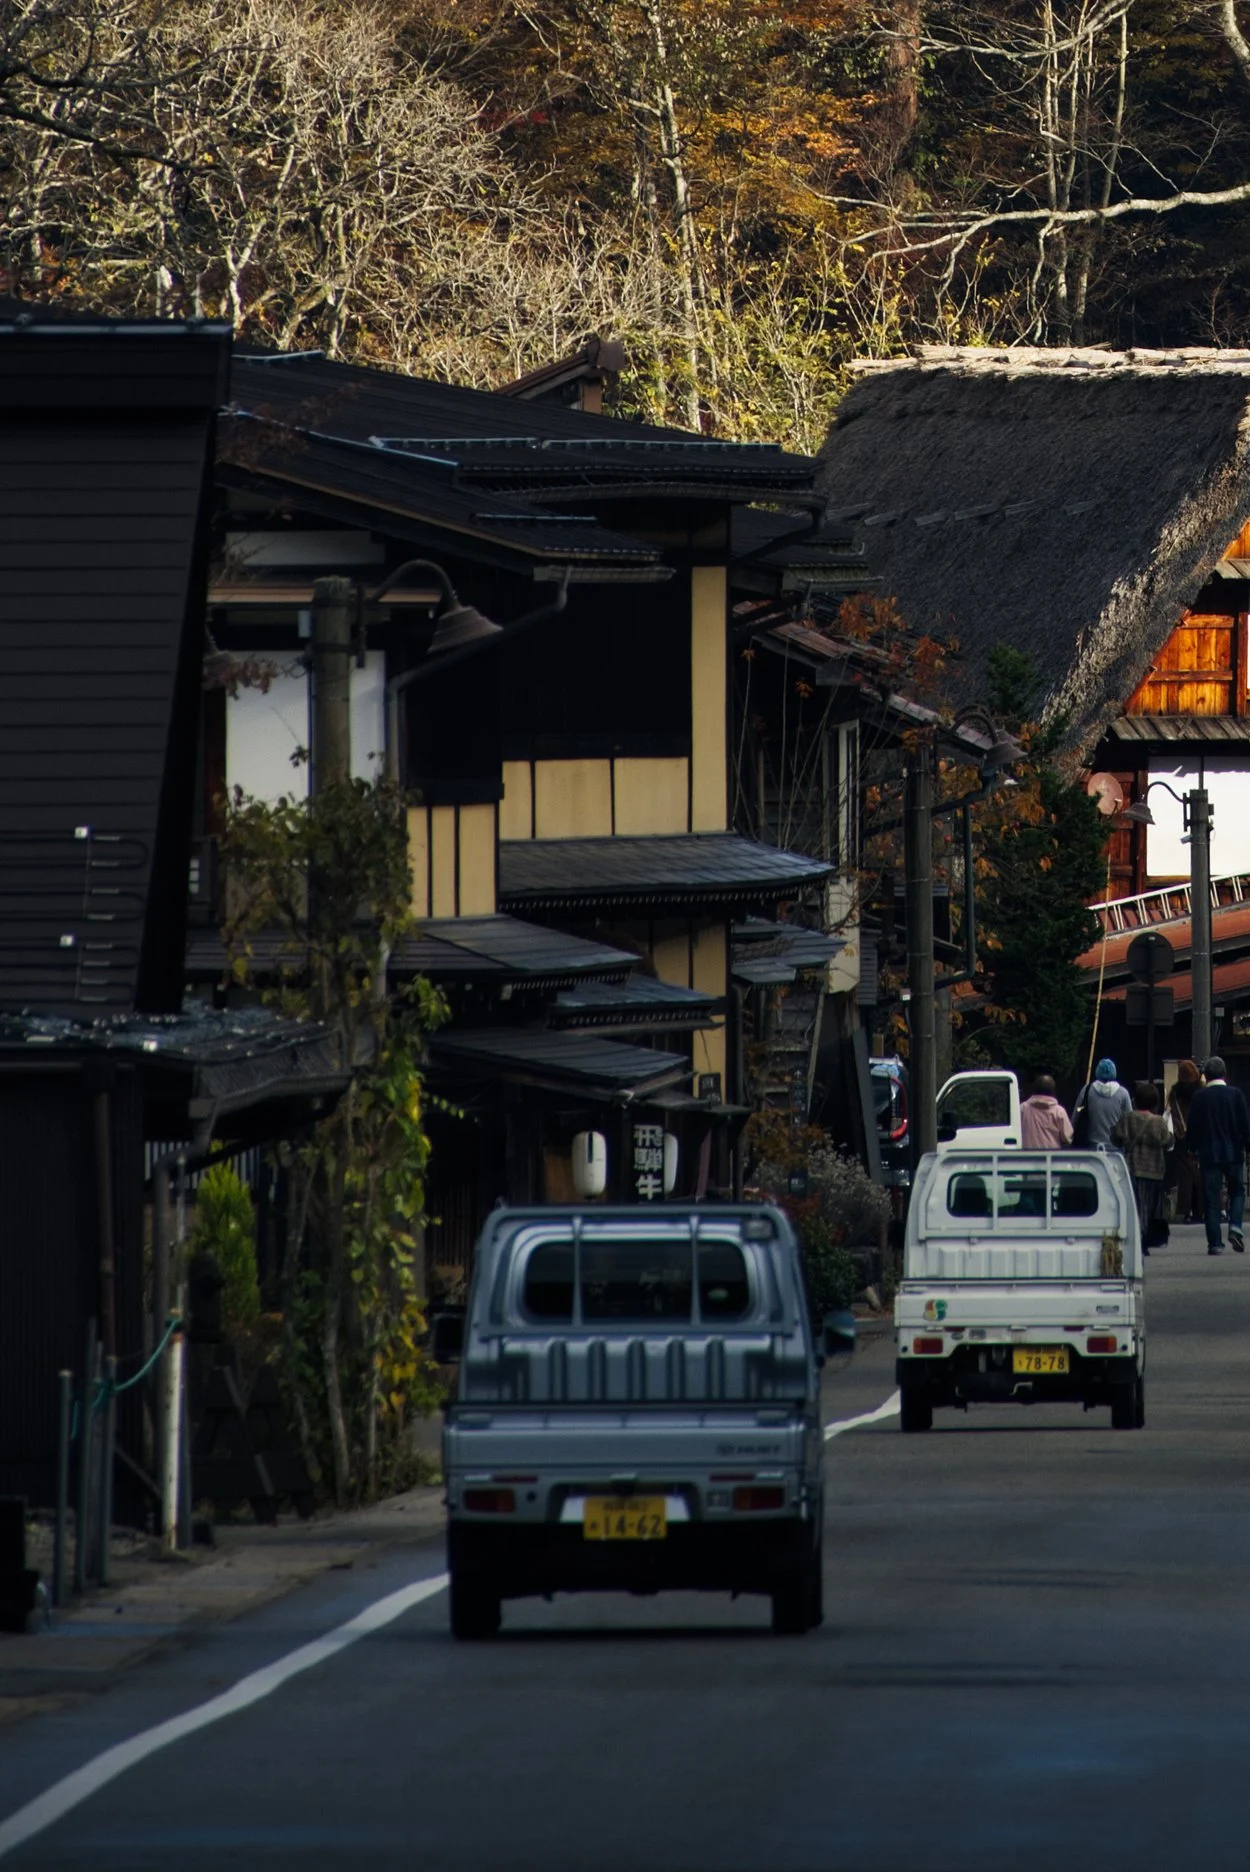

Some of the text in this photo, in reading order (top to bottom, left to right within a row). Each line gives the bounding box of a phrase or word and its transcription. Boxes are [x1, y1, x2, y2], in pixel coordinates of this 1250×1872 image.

[633, 1124, 663, 1200] 飛騨牛
[1026, 1356, 1065, 1370] 78-78
[603, 1515, 661, 1536] 14-62
